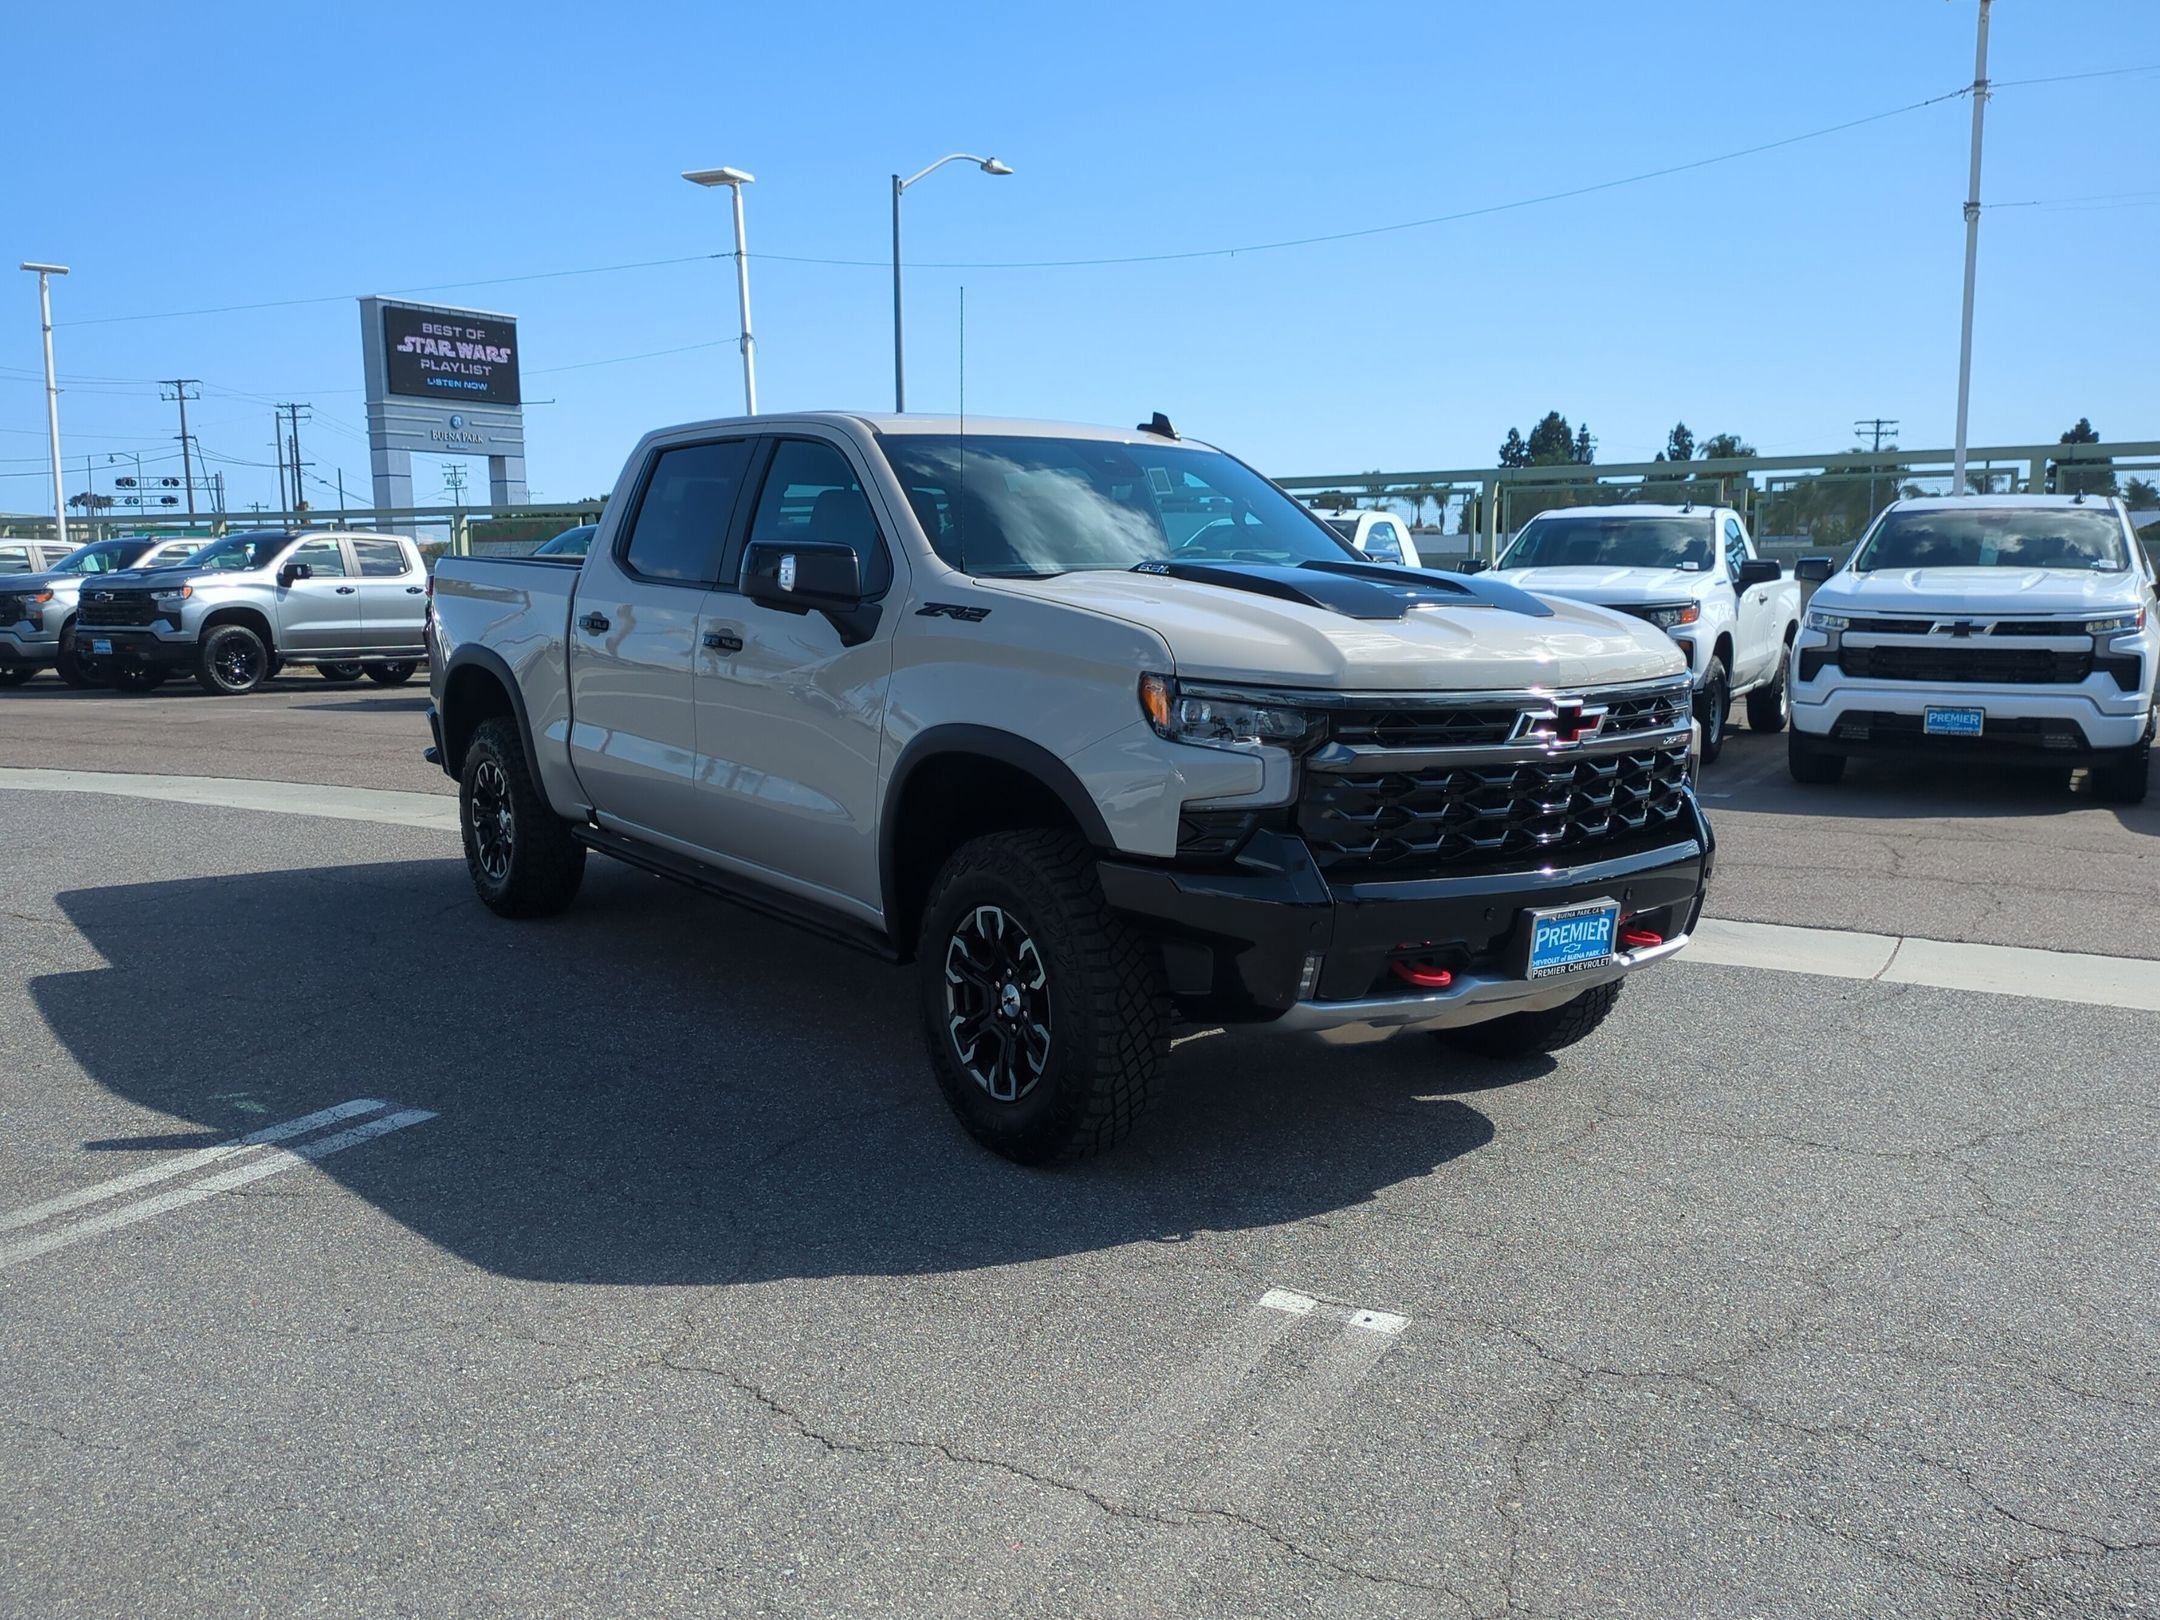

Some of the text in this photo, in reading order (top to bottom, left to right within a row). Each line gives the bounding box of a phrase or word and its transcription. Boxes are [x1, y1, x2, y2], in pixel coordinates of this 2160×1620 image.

[422, 322, 486, 340] BEST OF
[397, 335, 512, 364] STAR WARS
[421, 359, 492, 376] PLAYLIST
[427, 377, 488, 391] LISTEN NOW
[431, 430, 485, 444] BUENA PARK
[1928, 712, 1980, 726] PREMIER
[1557, 911, 1576, 920] BUENA
[1534, 917, 1610, 953] PREMIER
[1567, 953, 1585, 962] BUENA
[1532, 957, 1609, 979] PREMIER CHEVROLET
